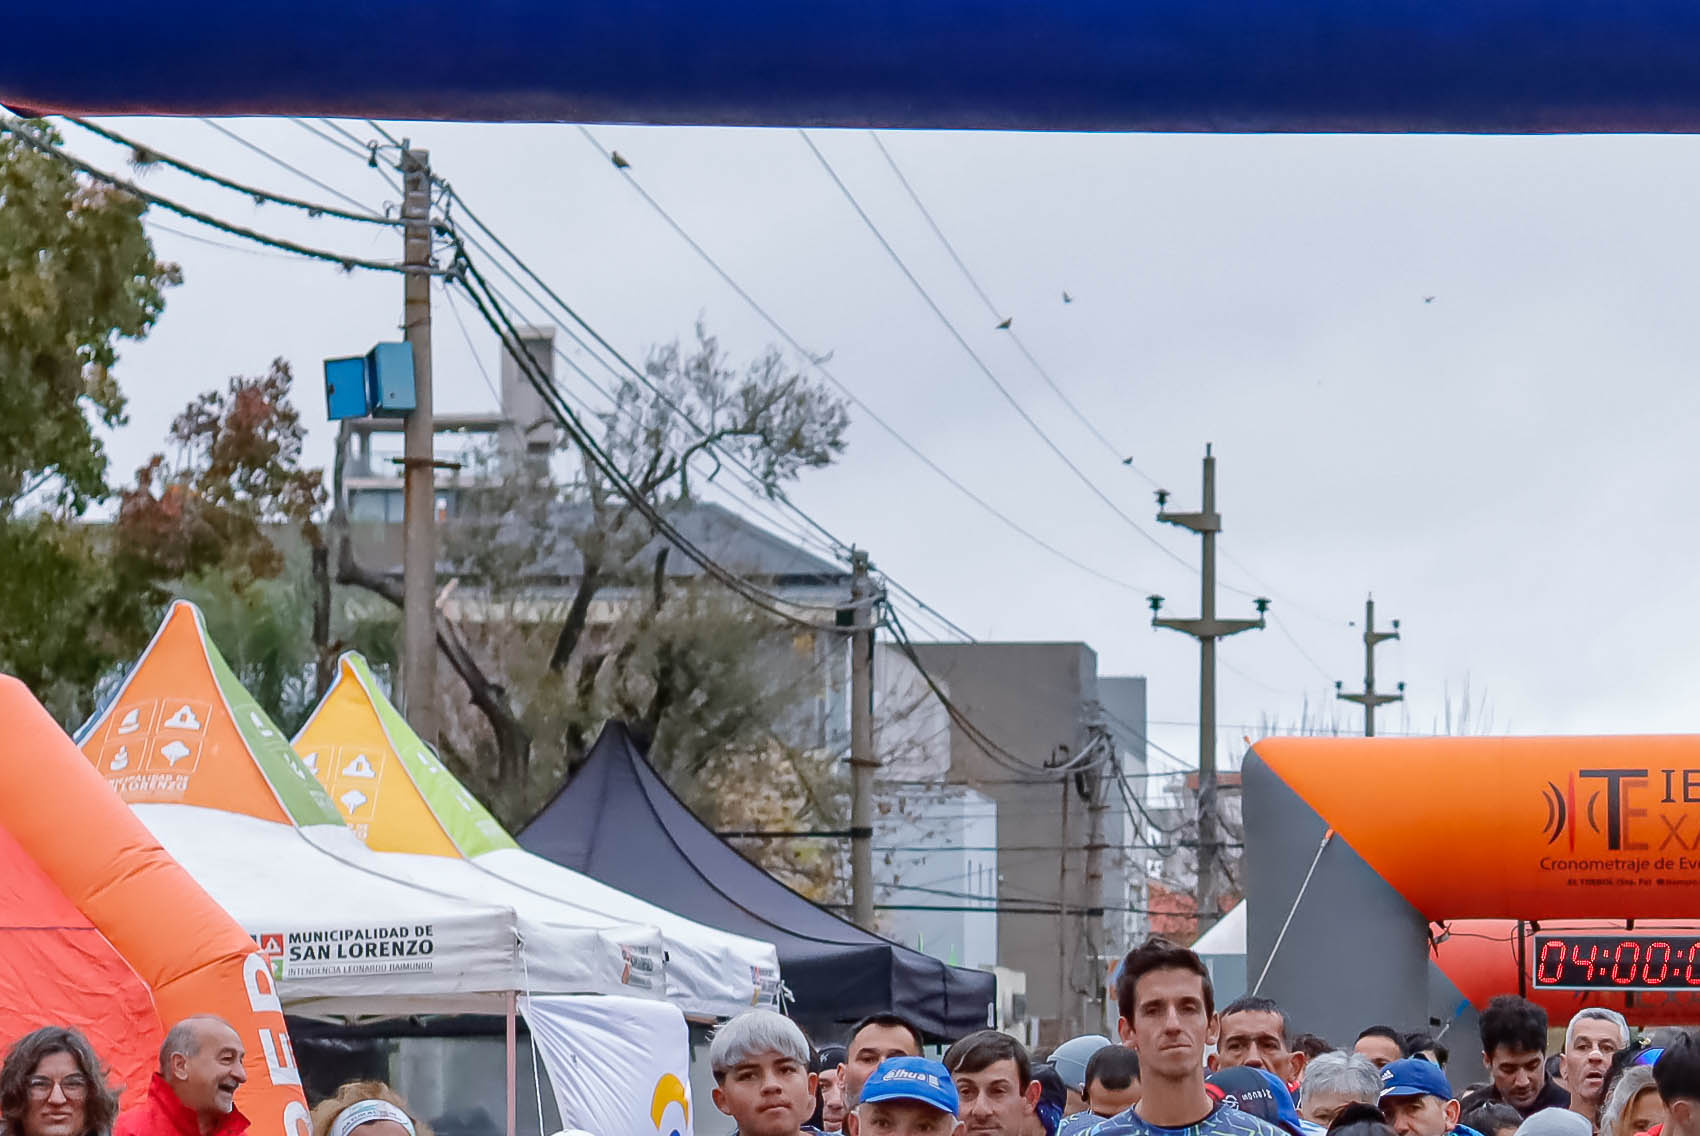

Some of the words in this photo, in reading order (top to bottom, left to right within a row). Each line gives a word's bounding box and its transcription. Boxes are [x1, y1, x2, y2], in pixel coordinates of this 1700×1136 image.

[1540, 856, 1649, 872] Cronometraje
[1654, 855, 1674, 869] de
[289, 927, 409, 944] MUNICIPALIDAD
[414, 925, 433, 936] DE
[289, 944, 330, 961] SAN
[337, 939, 434, 959] LORENZO
